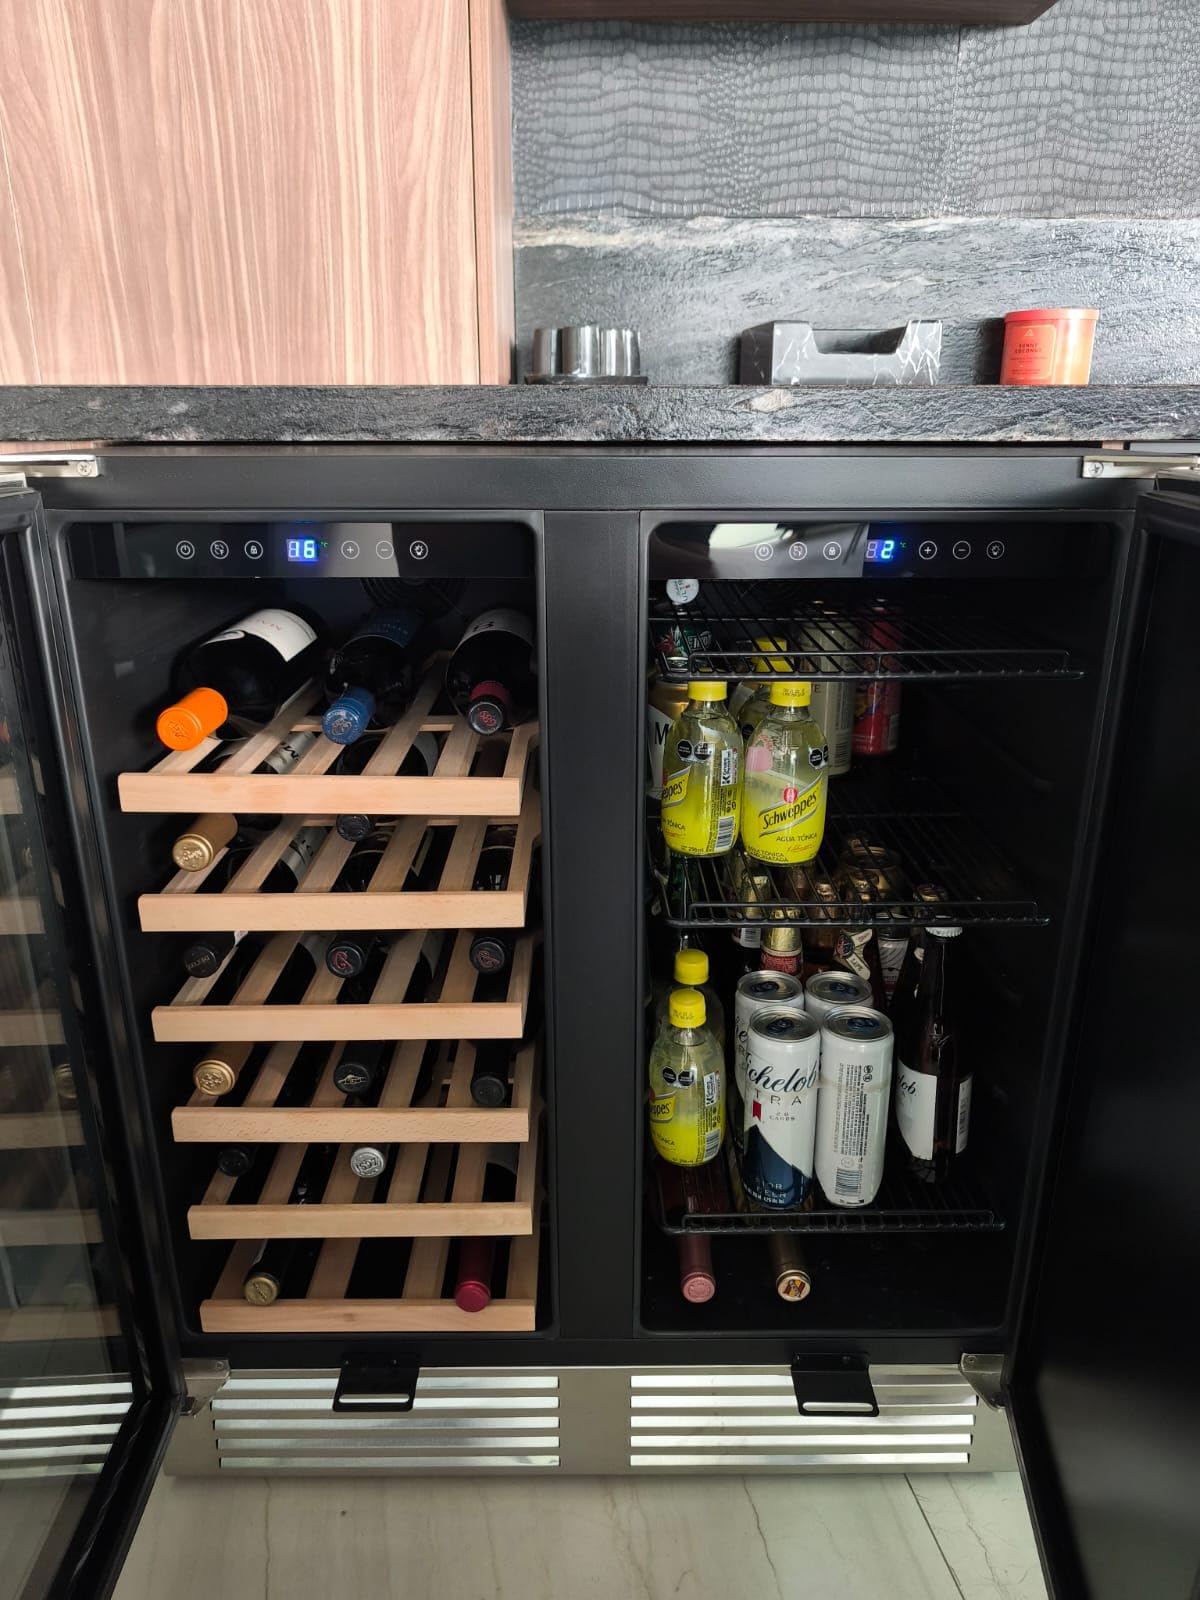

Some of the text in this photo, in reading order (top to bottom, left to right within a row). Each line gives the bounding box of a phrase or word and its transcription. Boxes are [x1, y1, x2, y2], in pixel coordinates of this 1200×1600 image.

[289, 540, 316, 559] 16
[662, 780, 685, 801] eppes
[762, 791, 817, 830] Schweppes
[755, 1089, 802, 1106] TRA
